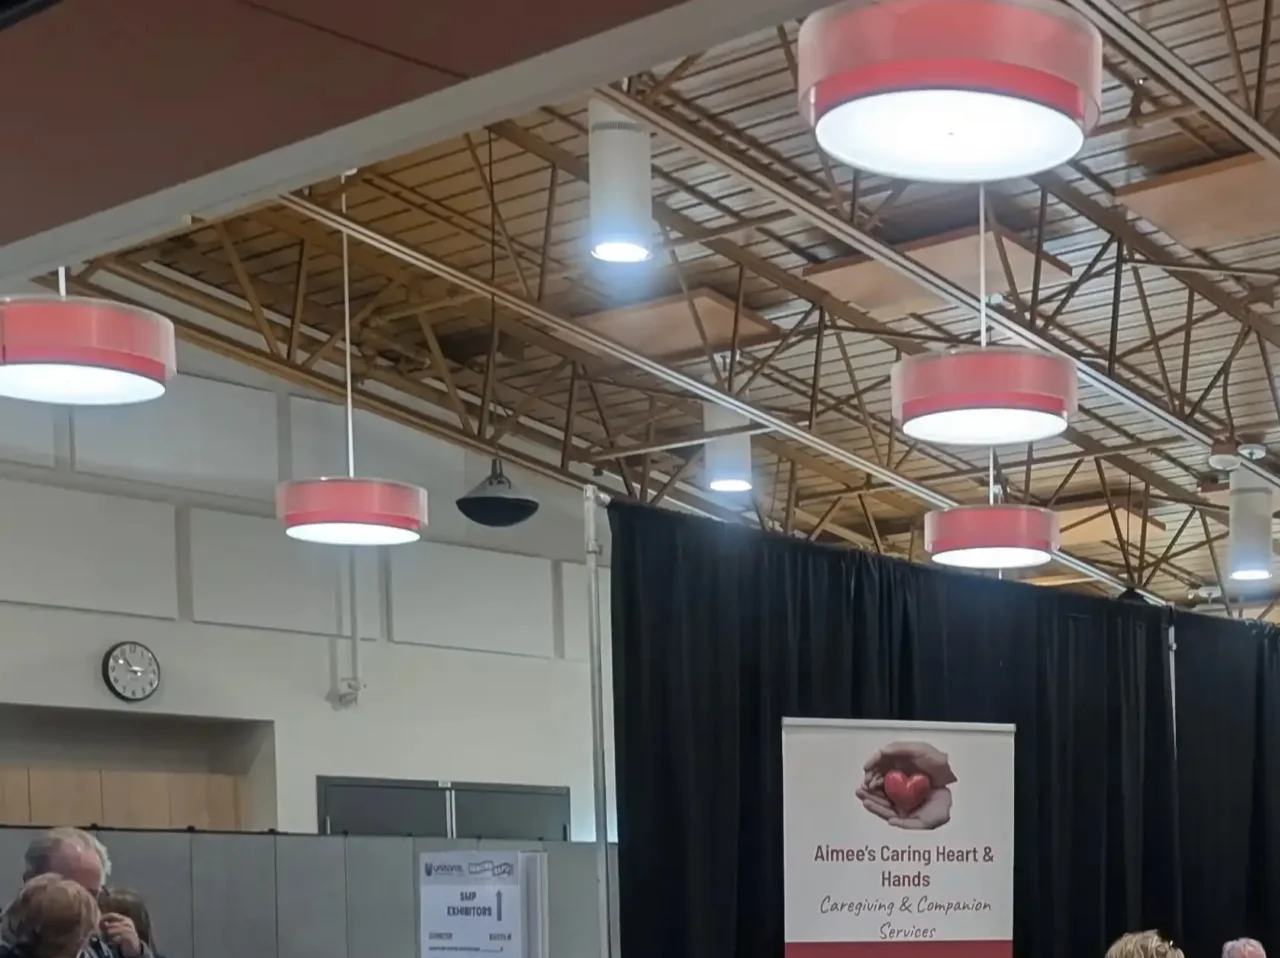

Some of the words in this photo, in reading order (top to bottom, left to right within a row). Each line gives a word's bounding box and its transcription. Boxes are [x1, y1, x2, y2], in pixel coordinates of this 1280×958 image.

[814, 845, 876, 862] Aimee's
[881, 846, 931, 865] Caring
[937, 847, 978, 861] Heart
[983, 847, 993, 862] &
[882, 871, 930, 887] Hands
[460, 892, 477, 901] SMP
[447, 906, 492, 916] EXHIBITORS
[820, 895, 894, 916] Caregiving
[900, 897, 912, 913] &
[917, 896, 991, 914] Companion
[880, 922, 936, 939] Services
